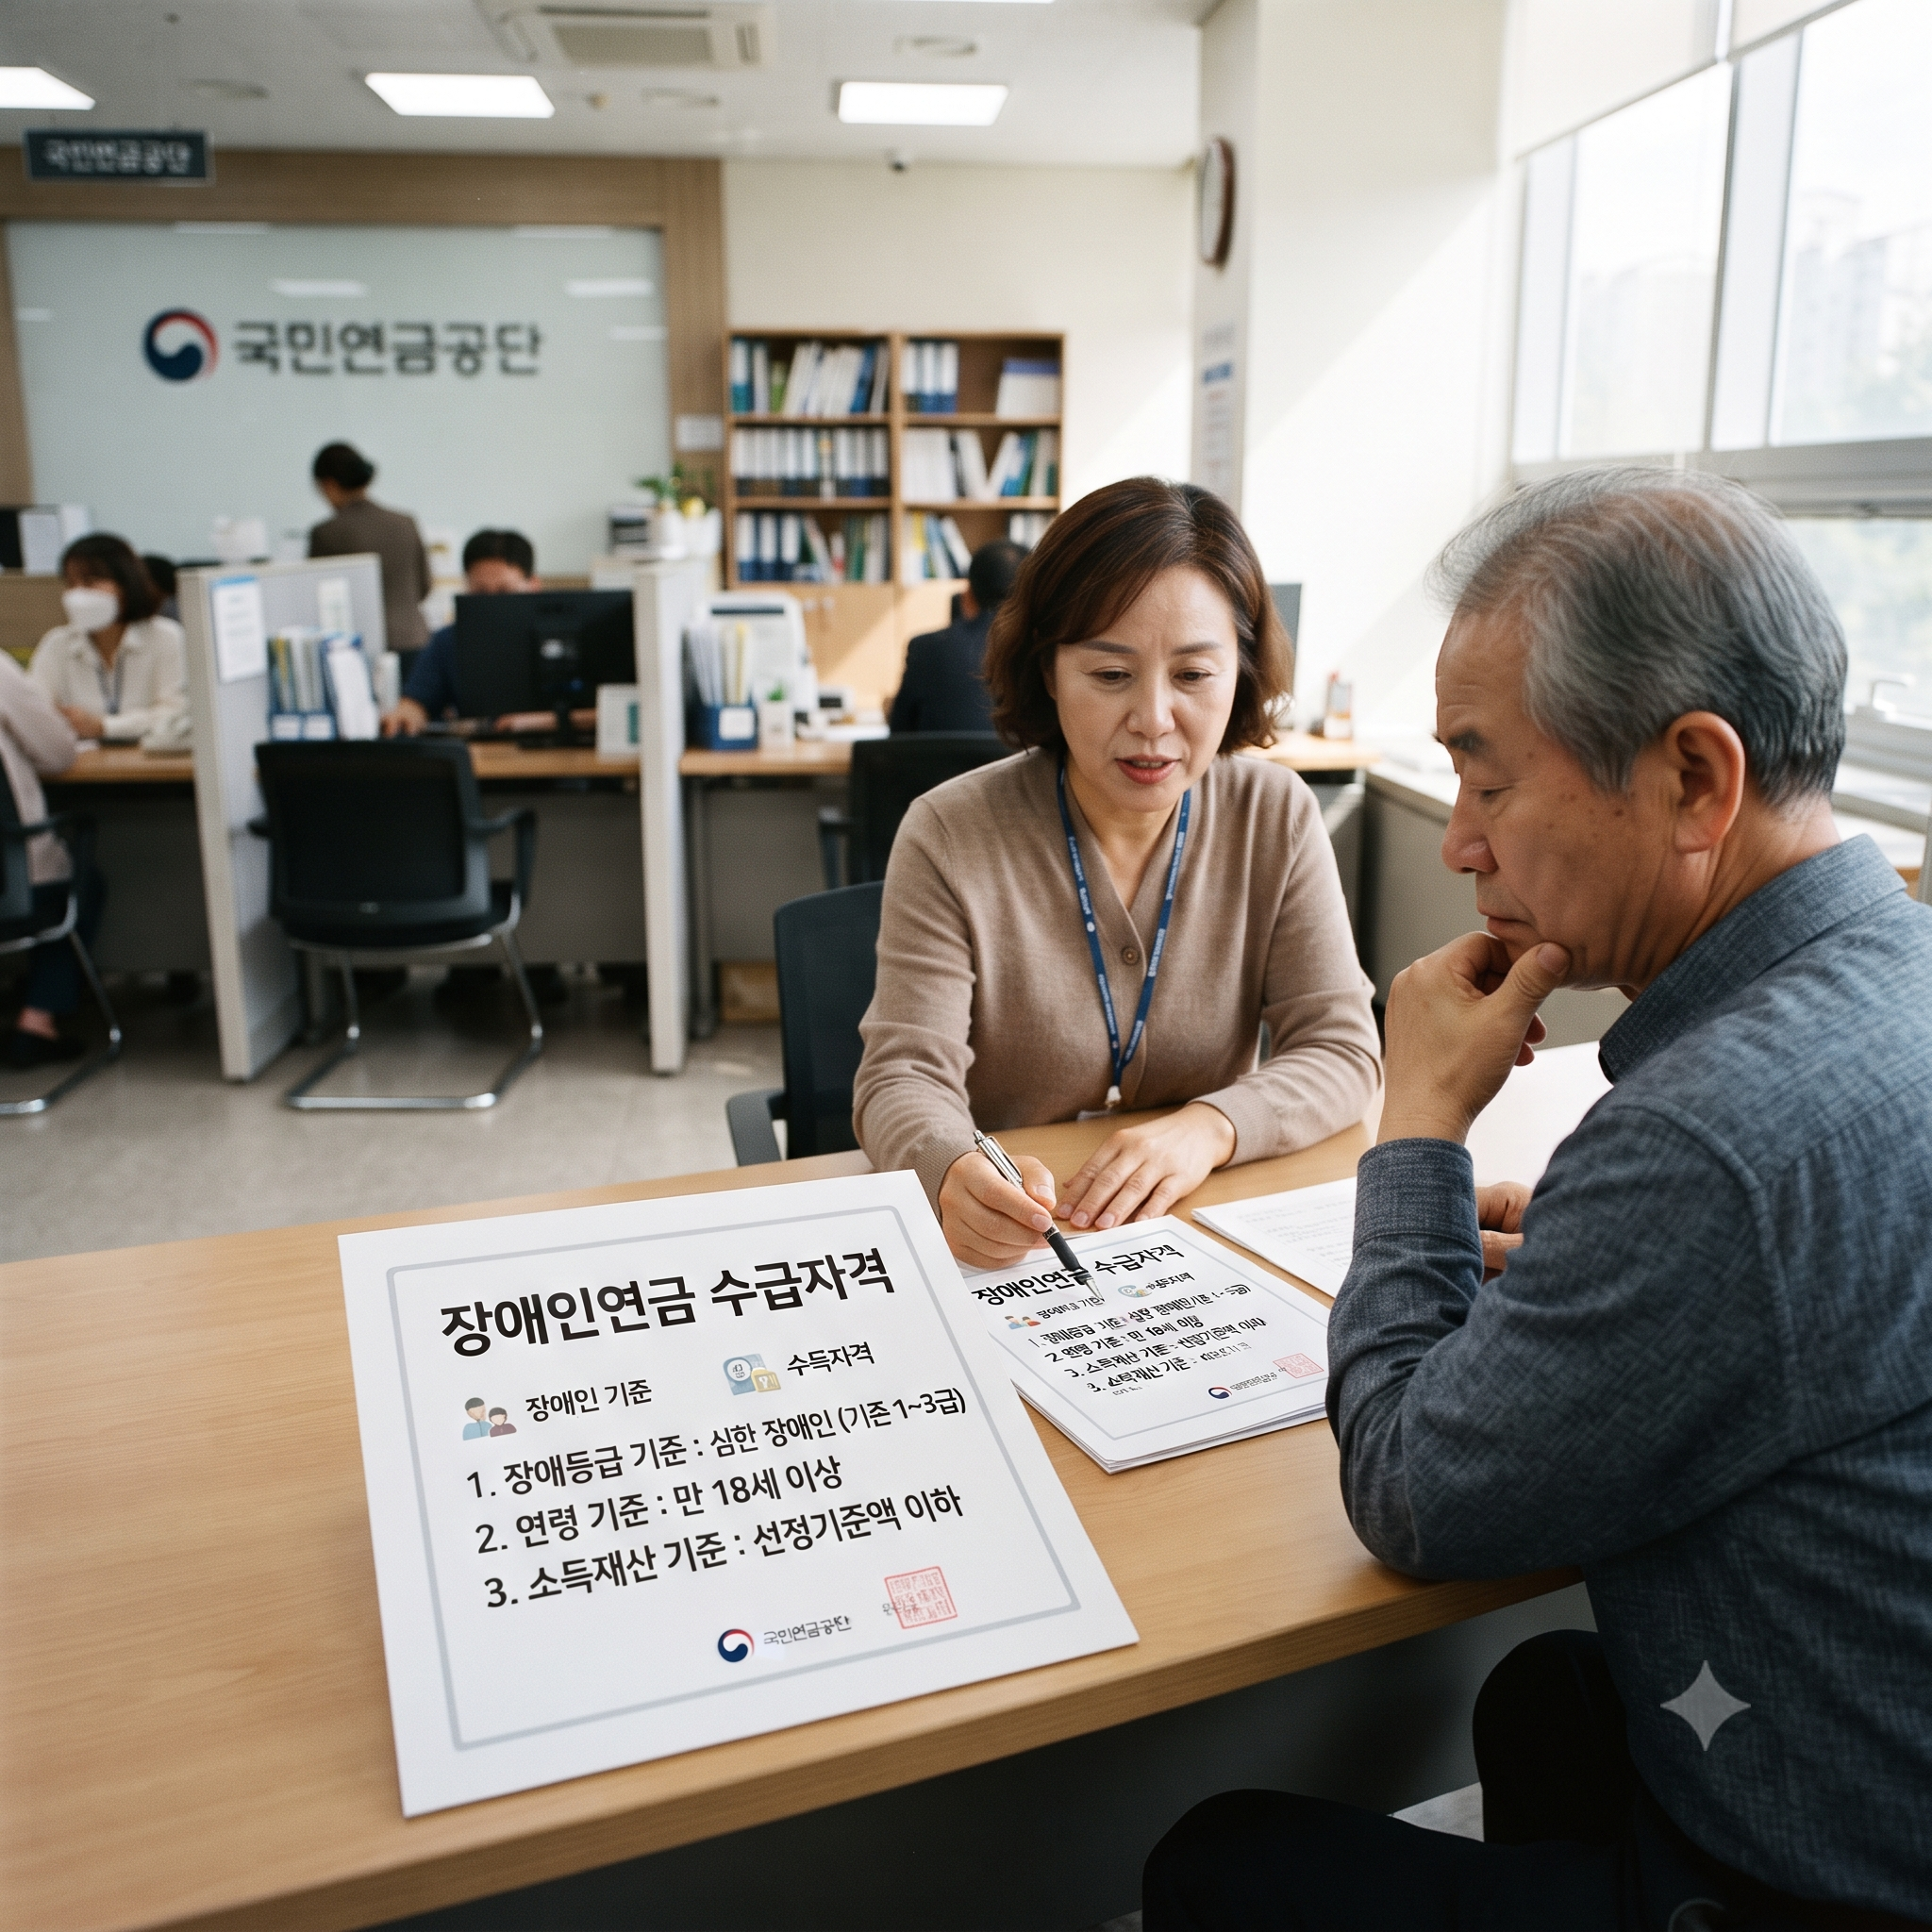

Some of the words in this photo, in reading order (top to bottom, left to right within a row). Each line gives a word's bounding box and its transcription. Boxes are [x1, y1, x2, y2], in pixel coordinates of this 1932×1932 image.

[234, 321, 540, 376] 국민연금공단
[440, 1274, 698, 1359] 장애인연금
[708, 1245, 896, 1318] 수급자격
[465, 1470, 498, 1500] 1.
[502, 1444, 625, 1496] 장애등급
[628, 1433, 689, 1471] 기준
[691, 1437, 705, 1457] :
[709, 1422, 758, 1459] 심한
[760, 1408, 837, 1448] 장애인
[838, 1400, 892, 1435] (기존
[891, 1387, 967, 1420] 1~3급)
[525, 1387, 600, 1423] 장애인
[603, 1377, 654, 1408] 기준
[474, 1522, 510, 1555] 2.
[514, 1504, 581, 1549] 연령
[587, 1492, 651, 1532] 기준
[655, 1493, 669, 1516] :
[672, 1480, 706, 1518] 만
[709, 1466, 783, 1507] 18세
[784, 1454, 843, 1494] 이상
[482, 1575, 520, 1608] 3.
[525, 1544, 659, 1601] 소득재산
[662, 1530, 728, 1573] 기준
[732, 1533, 746, 1556] :
[752, 1496, 903, 1558] 선정기준액
[903, 1483, 964, 1523] 이하
